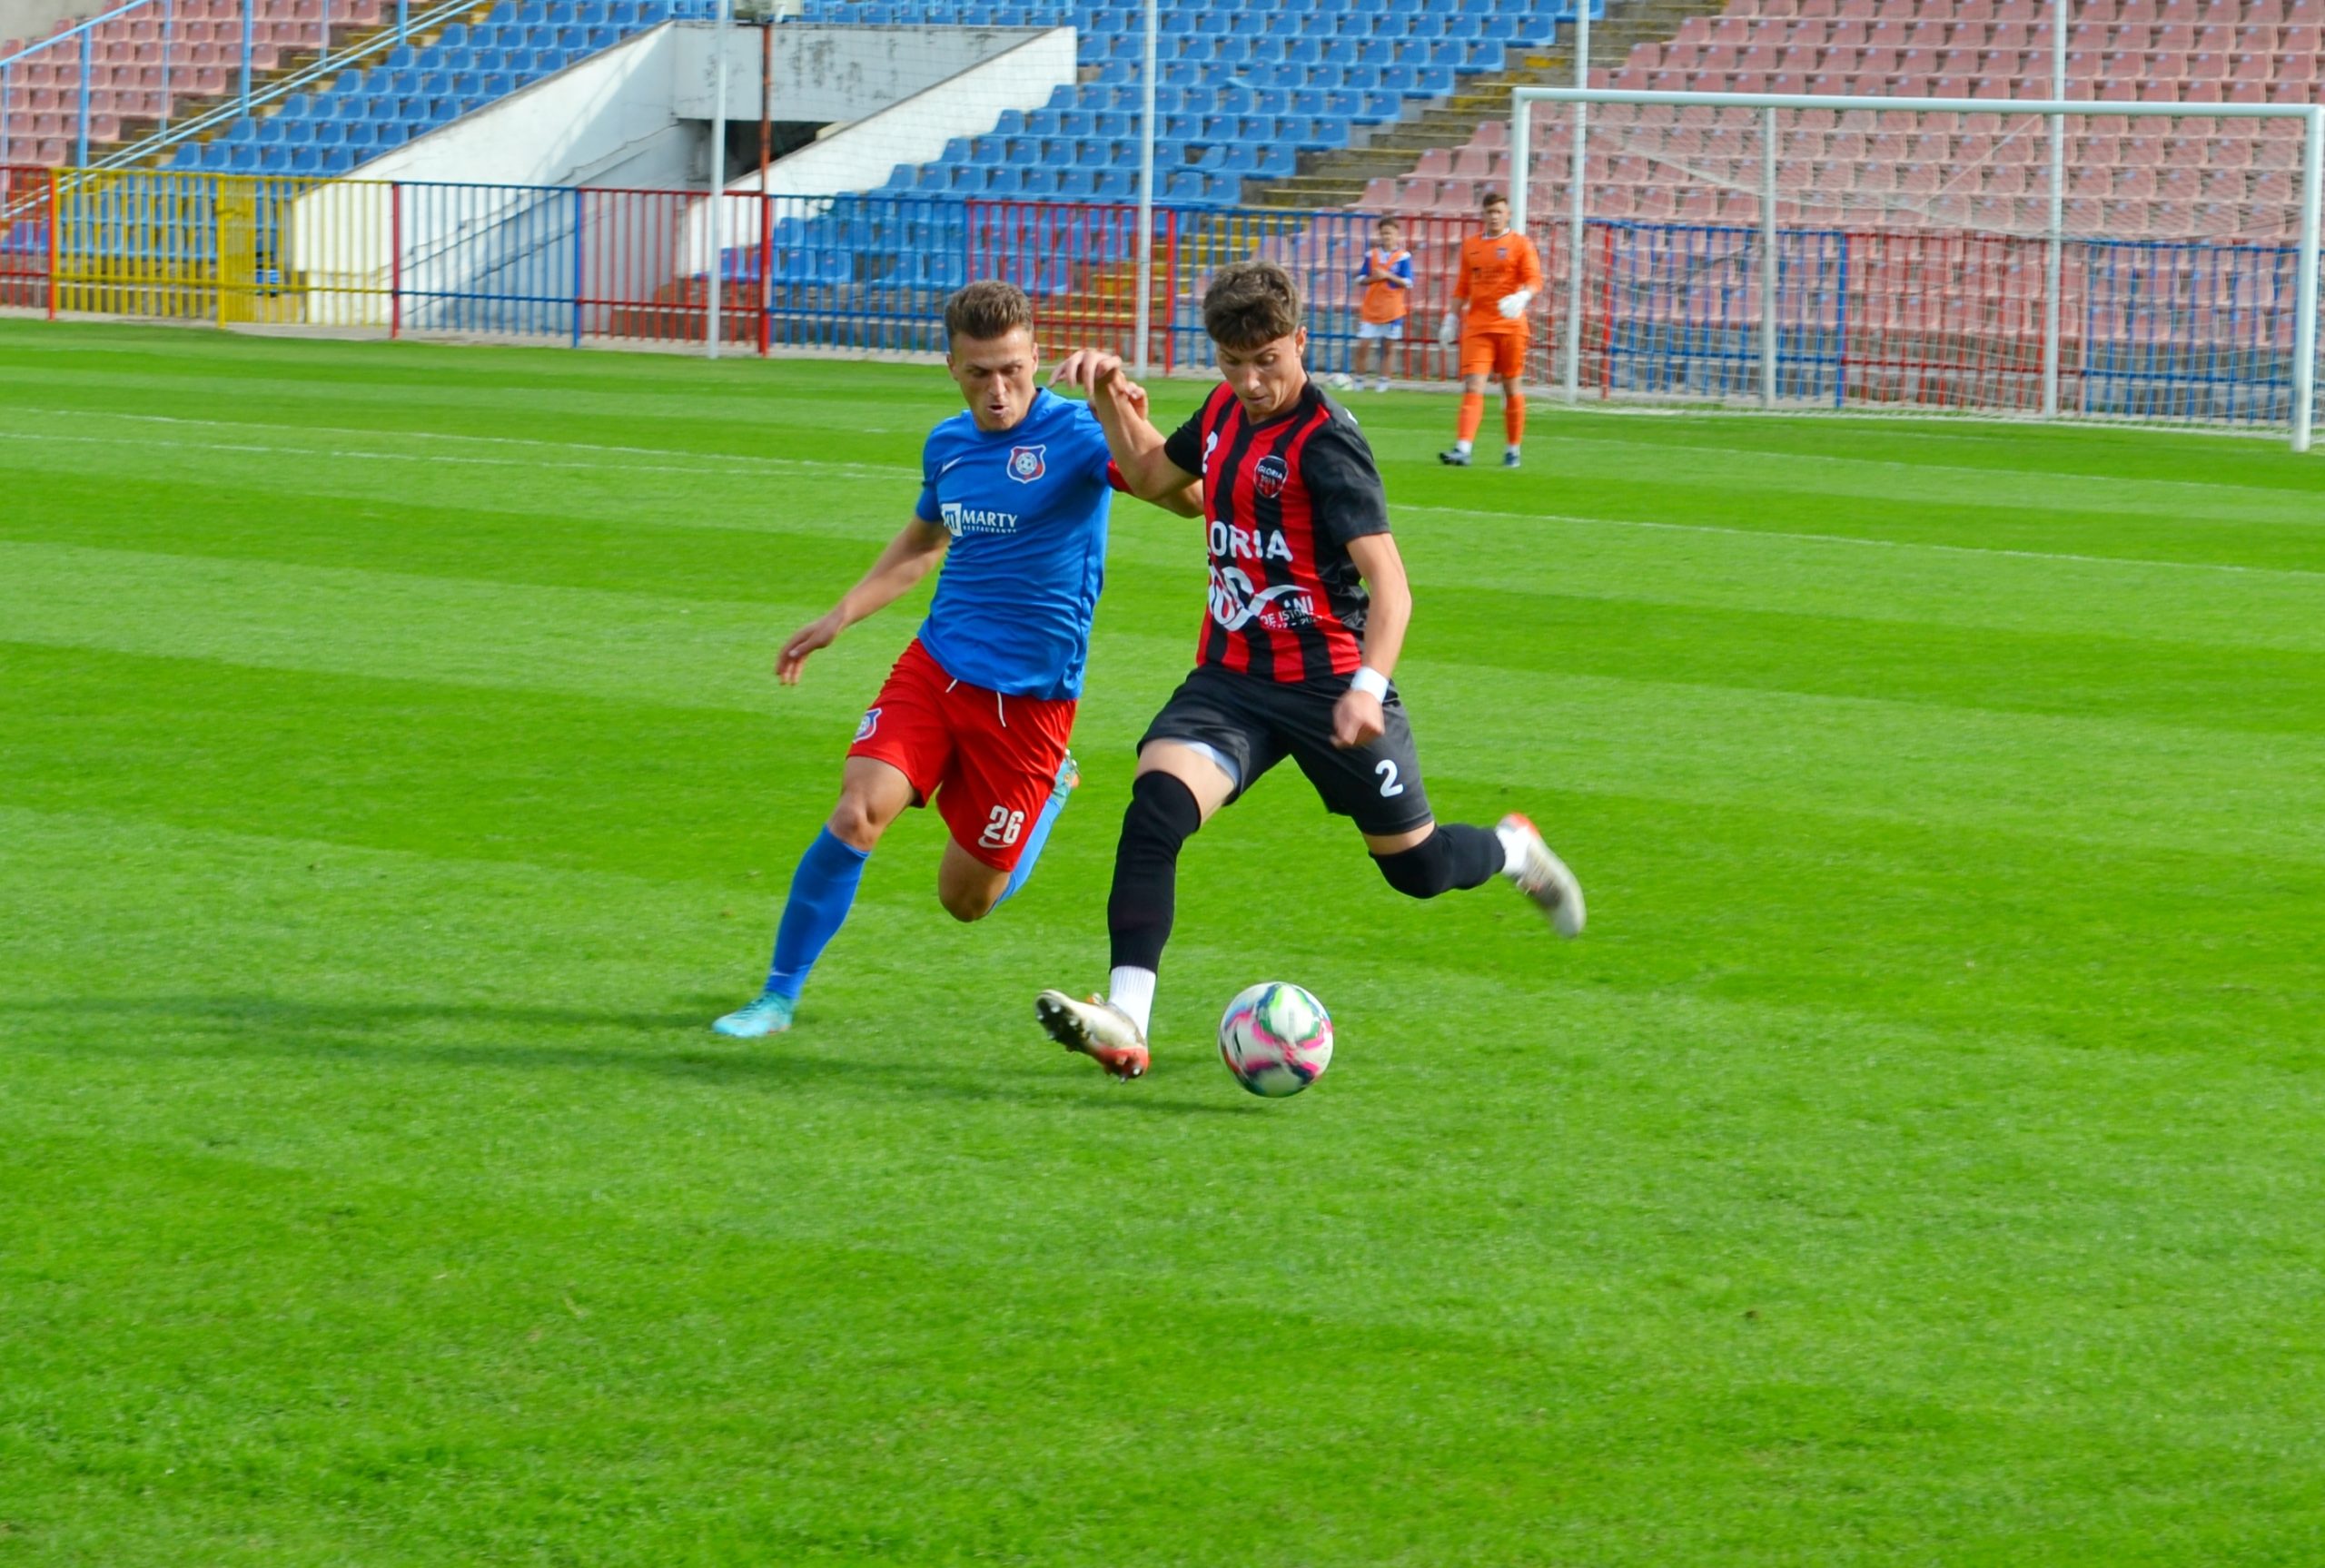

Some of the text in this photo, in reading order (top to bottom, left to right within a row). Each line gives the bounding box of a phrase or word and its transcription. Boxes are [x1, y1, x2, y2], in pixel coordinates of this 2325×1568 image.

[962, 508, 1017, 528] MARTY
[1207, 520, 1294, 563] ORIA
[1374, 759, 1404, 798] 2
[984, 804, 1025, 844] 26
